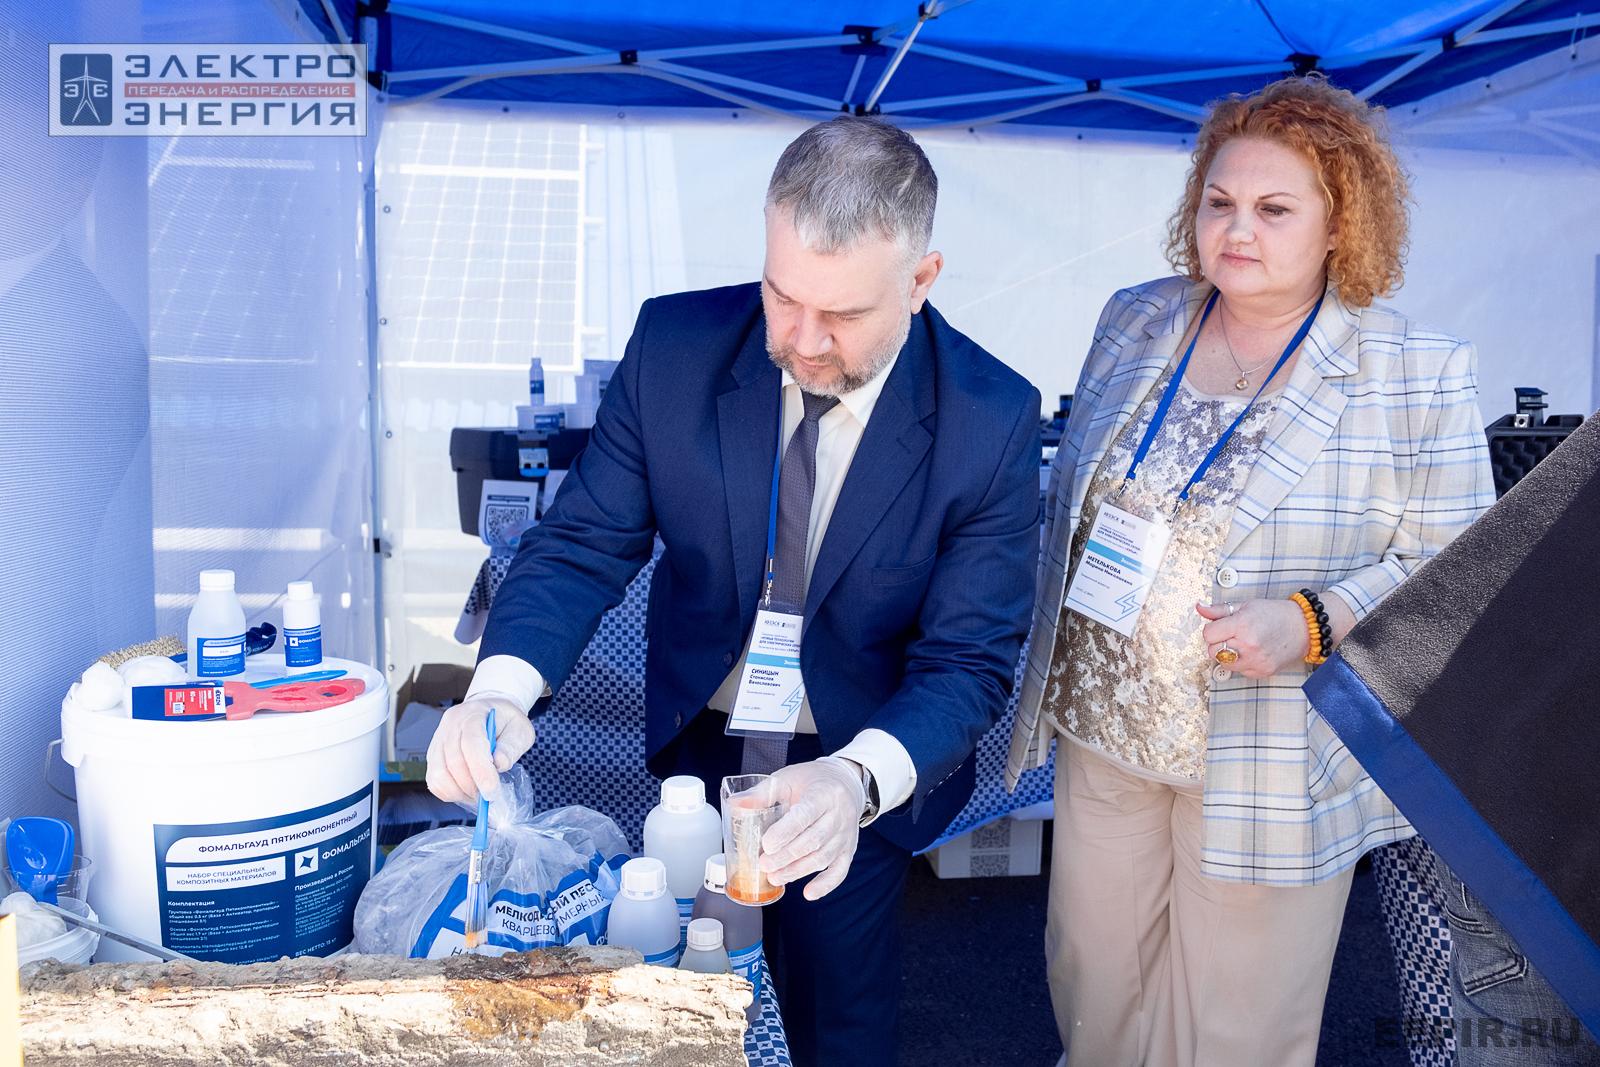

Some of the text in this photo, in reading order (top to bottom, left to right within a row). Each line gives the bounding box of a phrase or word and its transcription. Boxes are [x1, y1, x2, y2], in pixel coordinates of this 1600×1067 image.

[1087, 555, 1121, 574] МЕТЕЛЬКОВА
[751, 668, 779, 676] СИНИЦЫН
[198, 811, 358, 853] ФОМАЛЬГАУД ПЯТИКОМПОНЕНТНЫЙ
[322, 828, 371, 860] ФОМАЛЬГАУД
[176, 870, 277, 886] КОМПОЗИТНЫХ МАТЕРИАЛОВ
[212, 866, 265, 878] СПЕЦИАЛЬНЫХ
[294, 874, 334, 891] Произведено
